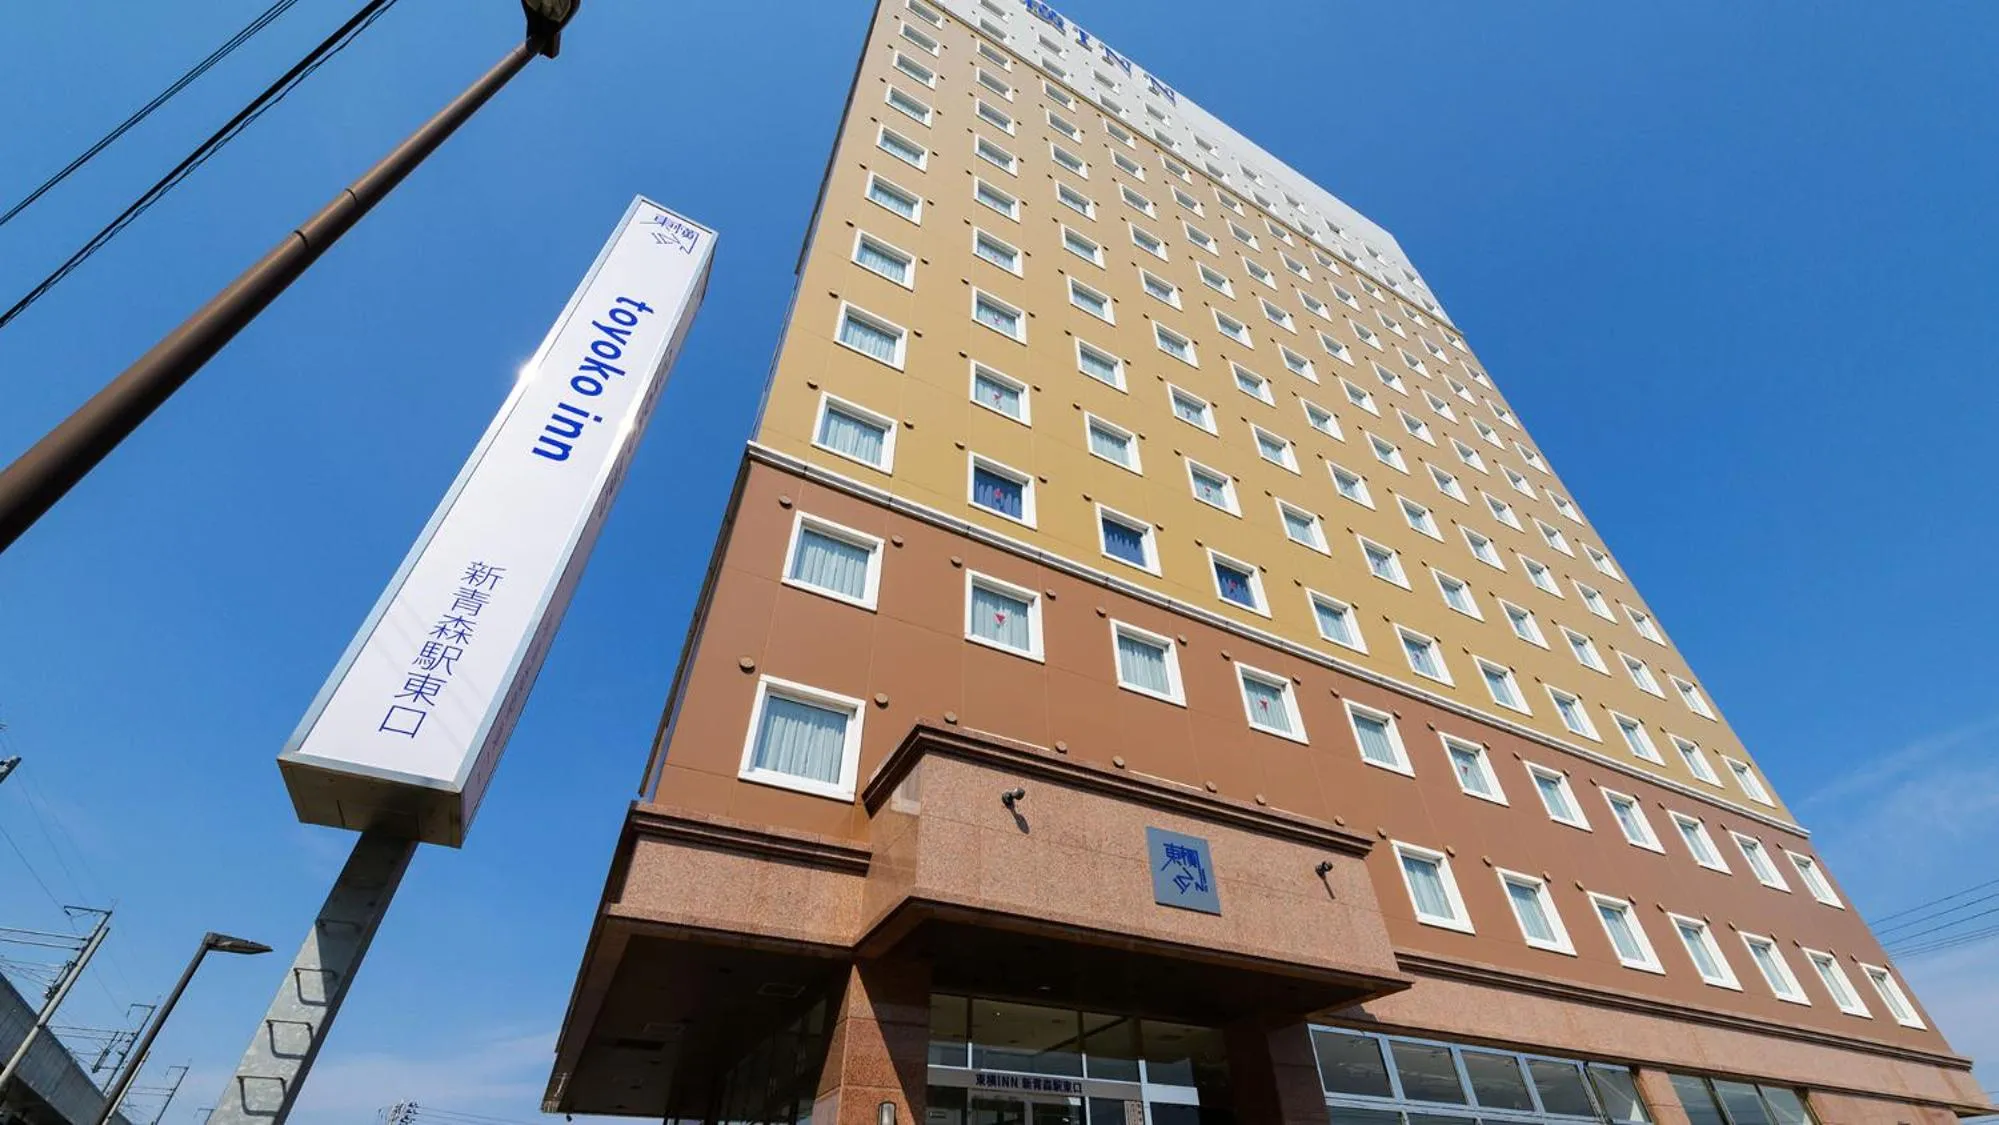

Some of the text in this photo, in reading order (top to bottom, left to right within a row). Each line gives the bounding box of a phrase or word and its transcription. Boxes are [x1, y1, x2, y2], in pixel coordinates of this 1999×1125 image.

[569, 296, 654, 397] toyoko
[532, 402, 603, 462] inn
[378, 561, 507, 739] 新青森駅東口
